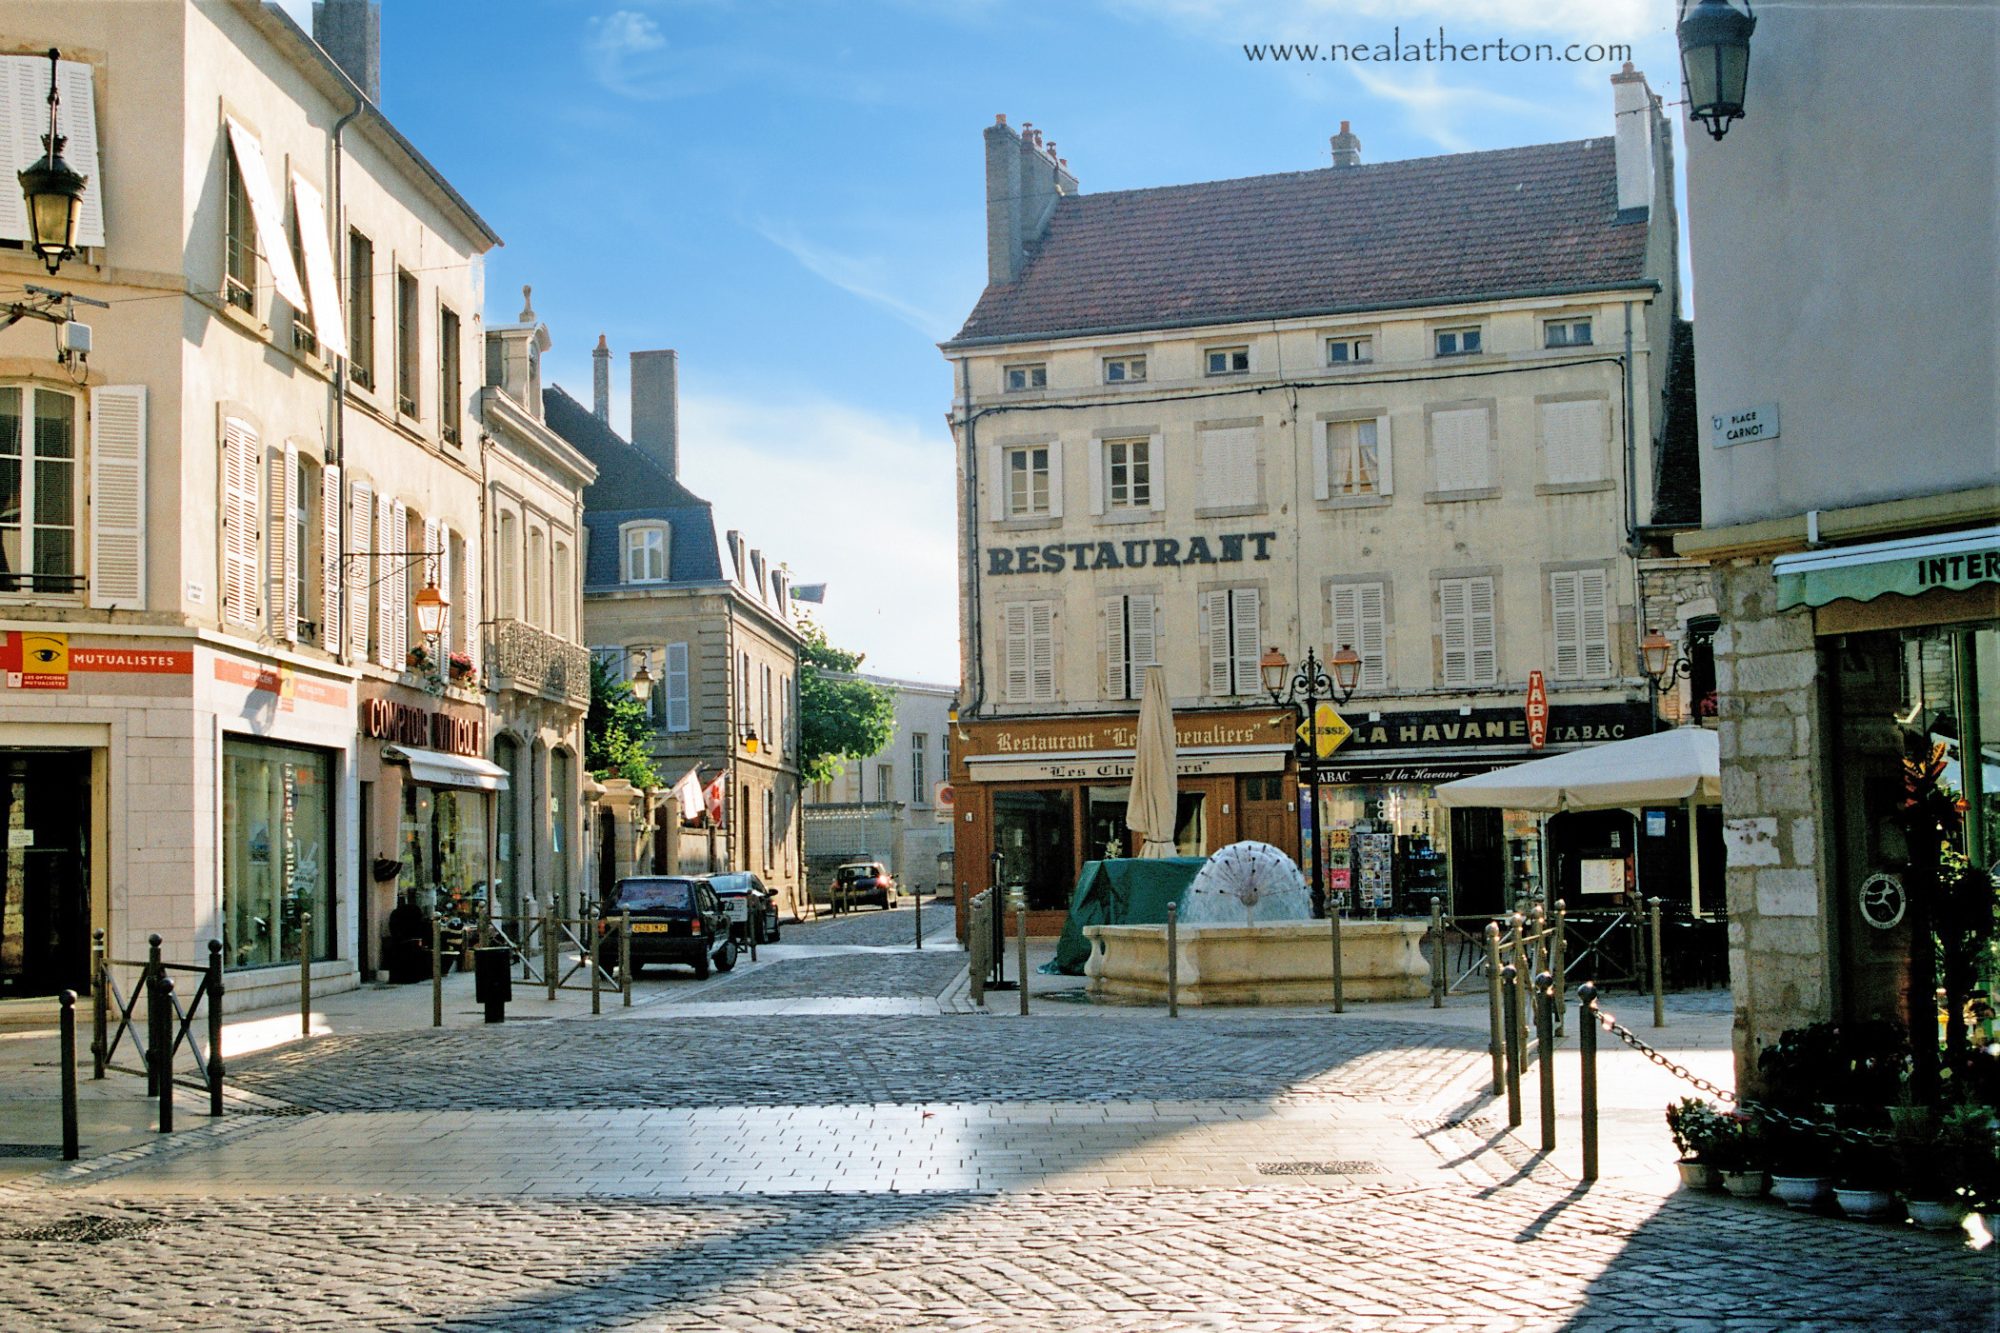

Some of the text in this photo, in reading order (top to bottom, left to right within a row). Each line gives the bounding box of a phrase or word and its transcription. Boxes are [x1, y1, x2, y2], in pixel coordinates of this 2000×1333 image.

[1731, 411, 1756, 424] PLACE
[1727, 424, 1763, 440] CARNOT
[987, 531, 1276, 576] RESTAURANT
[74, 654, 175, 667] MUTUALISTES
[1529, 673, 1544, 747] TABAC
[371, 697, 484, 757] COMPTOIR VITICOLE
[1302, 725, 1346, 736] PESSE
[1353, 720, 1525, 744] LA HAVANE
[1552, 724, 1625, 740] TABAC
[997, 732, 1094, 752] Restaurant
[1316, 771, 1351, 783] ABAC
[1399, 769, 1410, 780] la
[1411, 768, 1460, 780] Havane
